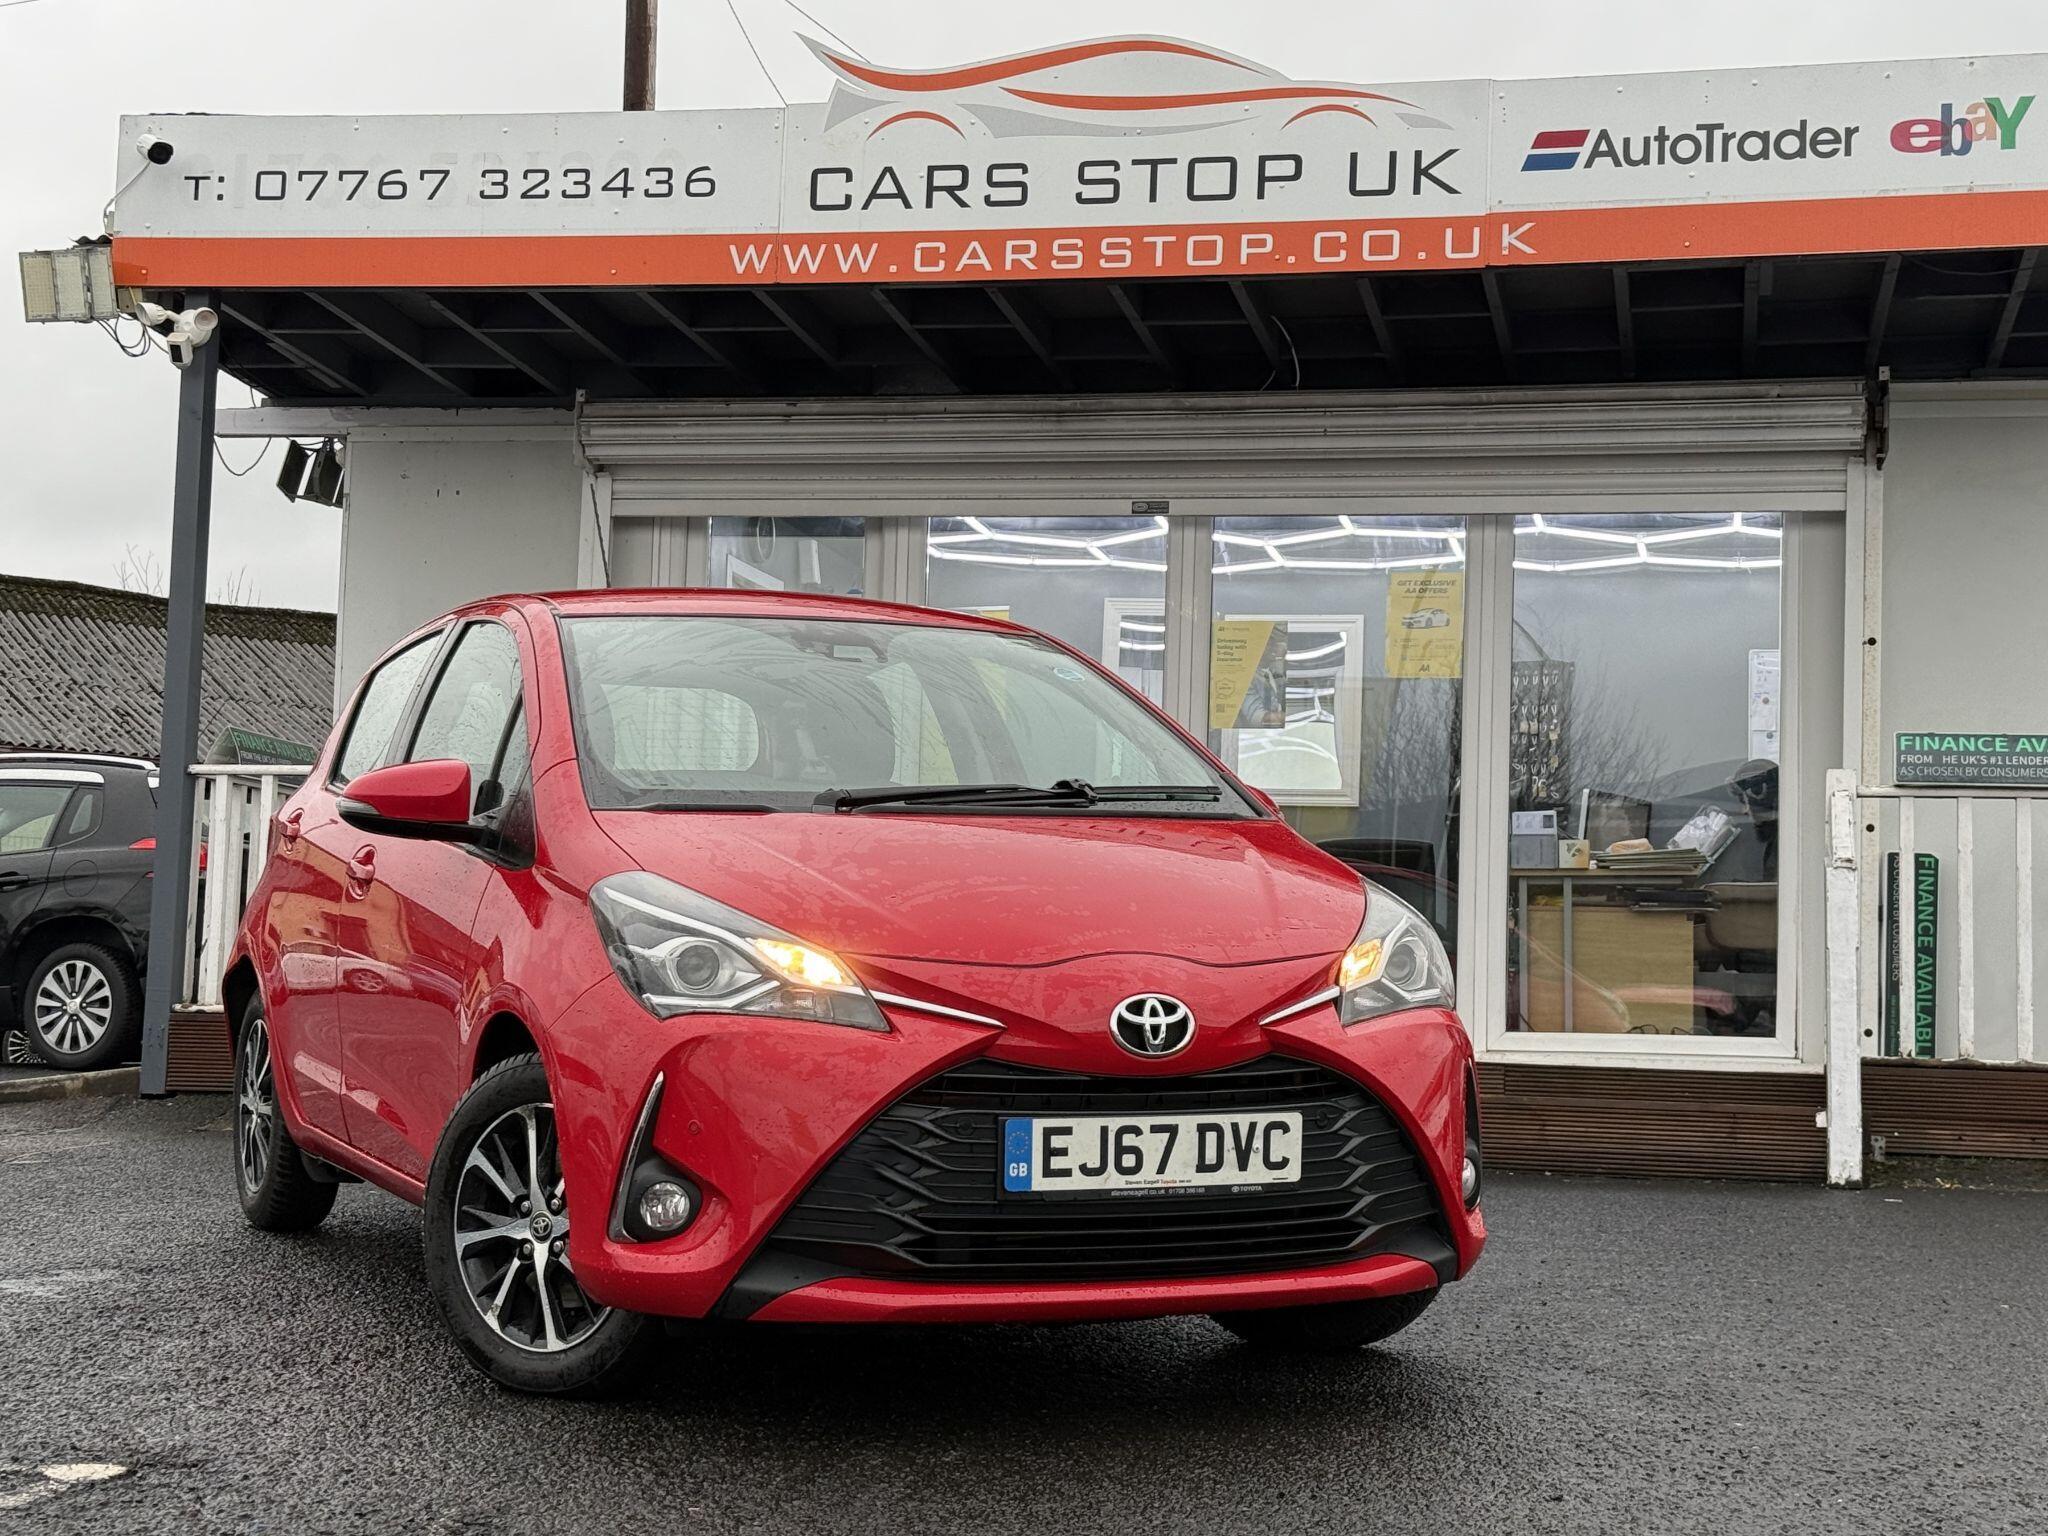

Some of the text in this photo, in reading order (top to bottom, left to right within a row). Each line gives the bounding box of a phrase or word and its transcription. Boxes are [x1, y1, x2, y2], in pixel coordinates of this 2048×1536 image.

[1584, 119, 1859, 169] AutoTrader
[184, 165, 717, 201] T: 07767 323436
[810, 148, 1462, 211] CARS STOP UK
[729, 222, 1537, 274] WWW.CARSSTOP.CO.UK
[1900, 736, 2048, 753] FINANCE AV
[1901, 754, 1933, 764] FROM
[1961, 755, 1987, 765] UK'S
[1990, 755, 2004, 765] #1
[1900, 766, 1915, 776] AS
[1916, 766, 1962, 777] CHOSEN
[1965, 766, 1978, 777] BY
[1917, 857, 1935, 948] FINANCE
[1009, 1163, 1028, 1177] GB
[1042, 1120, 1292, 1178] EJ67 DVC
